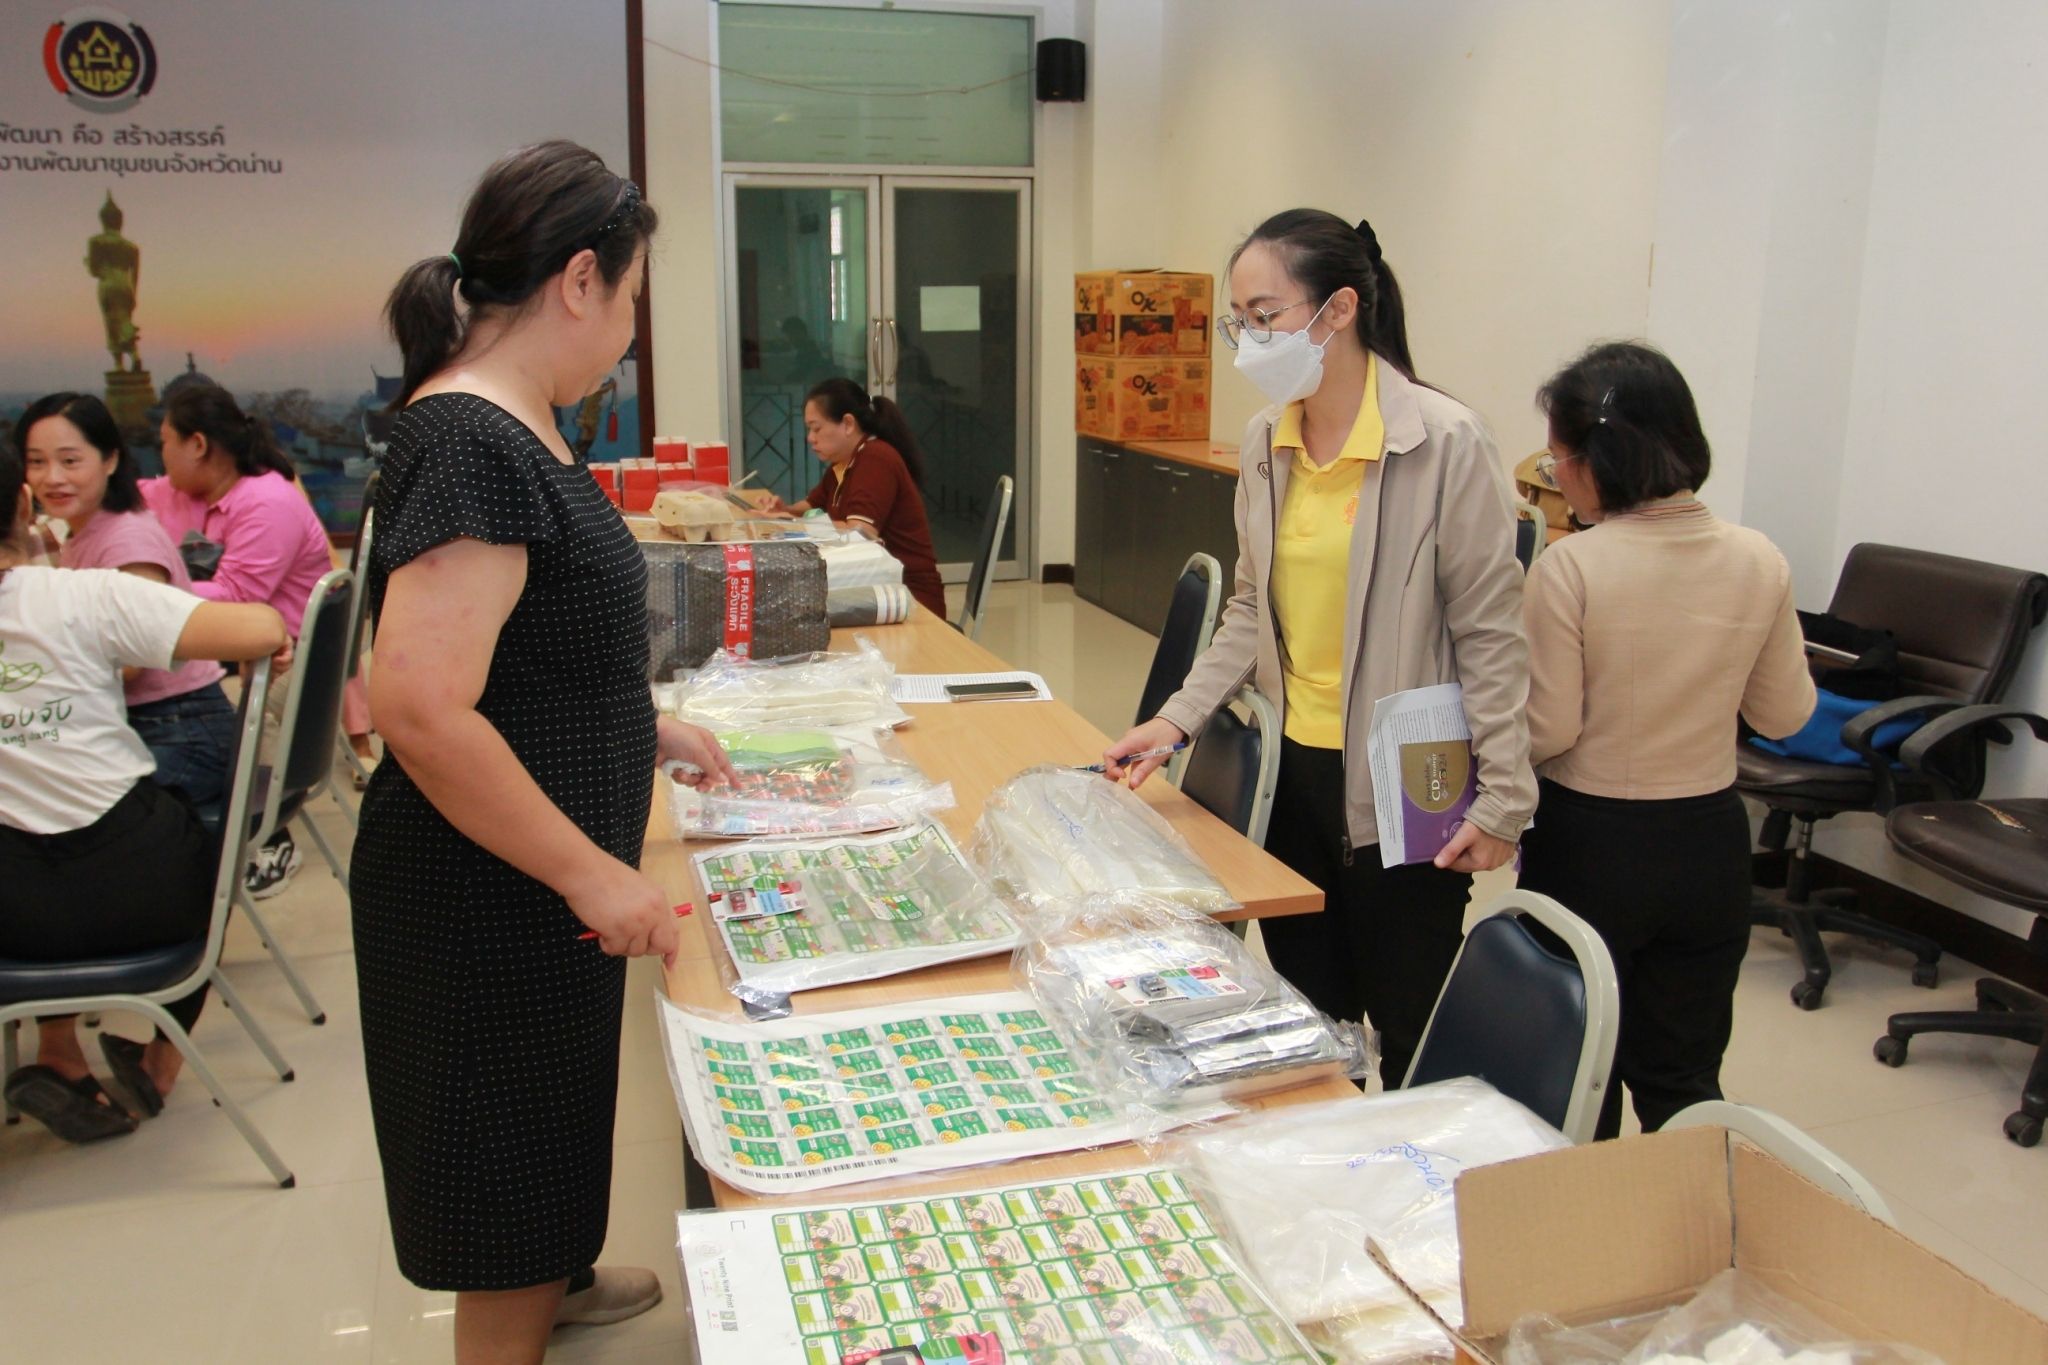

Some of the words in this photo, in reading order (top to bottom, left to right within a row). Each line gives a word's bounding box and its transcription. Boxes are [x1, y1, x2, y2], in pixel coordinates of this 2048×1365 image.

[72, 123, 103, 145] คือ
[113, 124, 226, 146] สร้างสรรค์
[728, 577, 740, 631] ระวังแตก
[739, 577, 749, 632] FRAGILE
